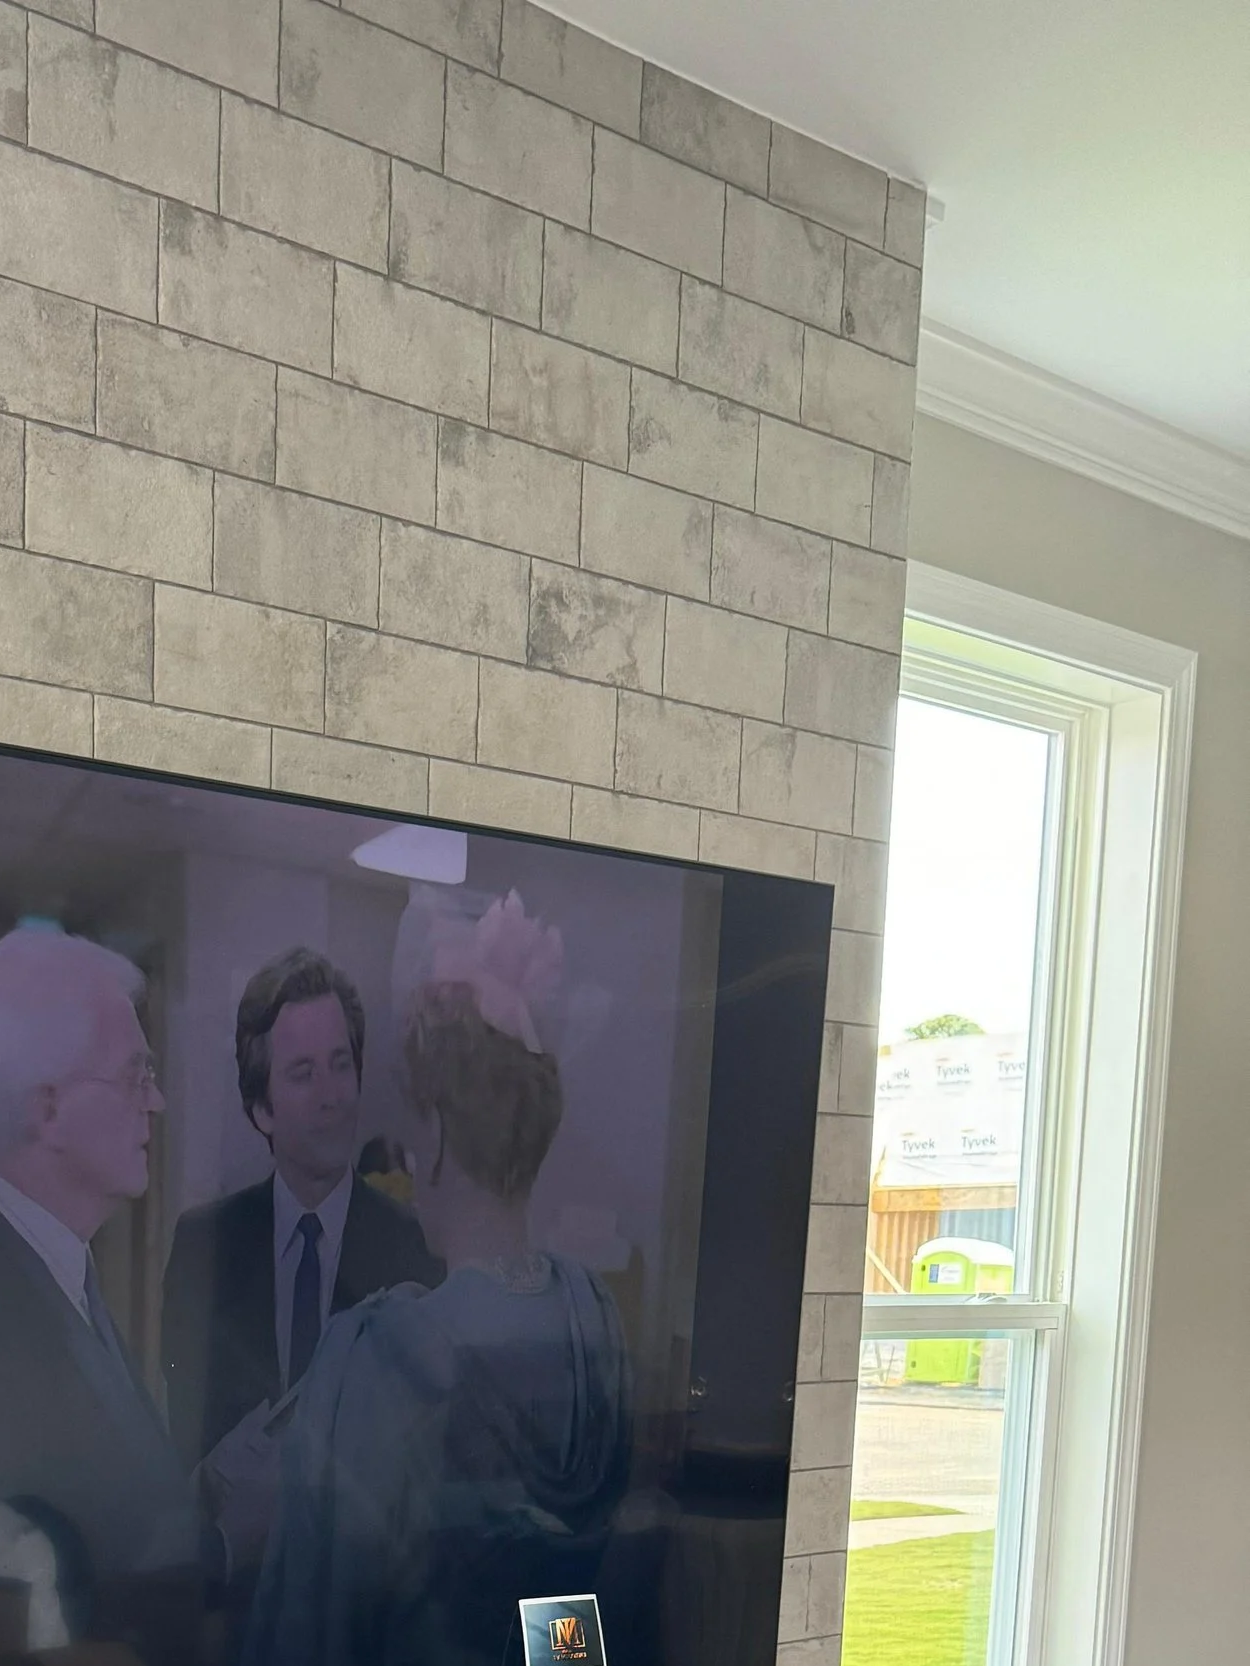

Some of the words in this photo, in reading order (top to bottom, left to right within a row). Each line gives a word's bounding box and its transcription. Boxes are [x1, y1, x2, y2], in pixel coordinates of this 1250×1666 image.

[937, 1064, 970, 1079] Tyvek
[998, 1060, 1025, 1072] Tyve
[902, 1138, 935, 1153] Tyvek
[962, 1134, 996, 1150] Tyvek
